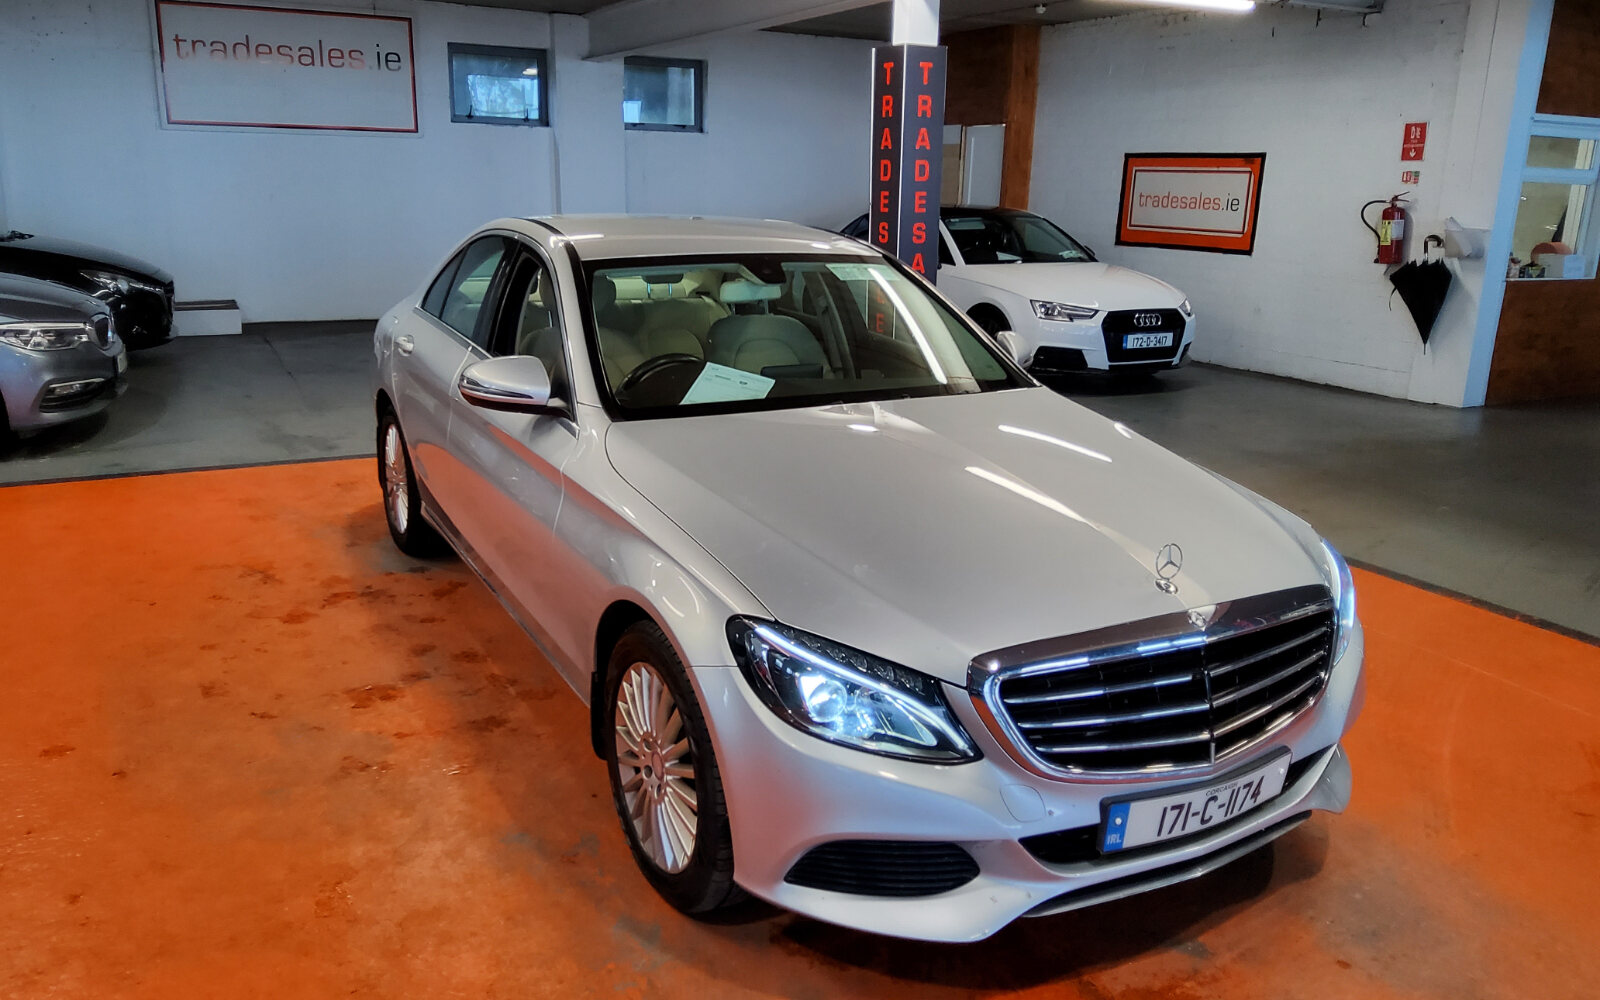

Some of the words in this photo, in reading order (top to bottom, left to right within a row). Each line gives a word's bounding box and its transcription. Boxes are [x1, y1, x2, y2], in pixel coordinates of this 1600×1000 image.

[172, 33, 402, 72] tradesales.ie
[911, 61, 934, 274] TRADESA
[1138, 191, 1240, 212] tradesales.ie
[1132, 335, 1168, 347] 172-D-3417
[1156, 775, 1265, 837] 171-C-1174
[1106, 833, 1122, 845] IRL
